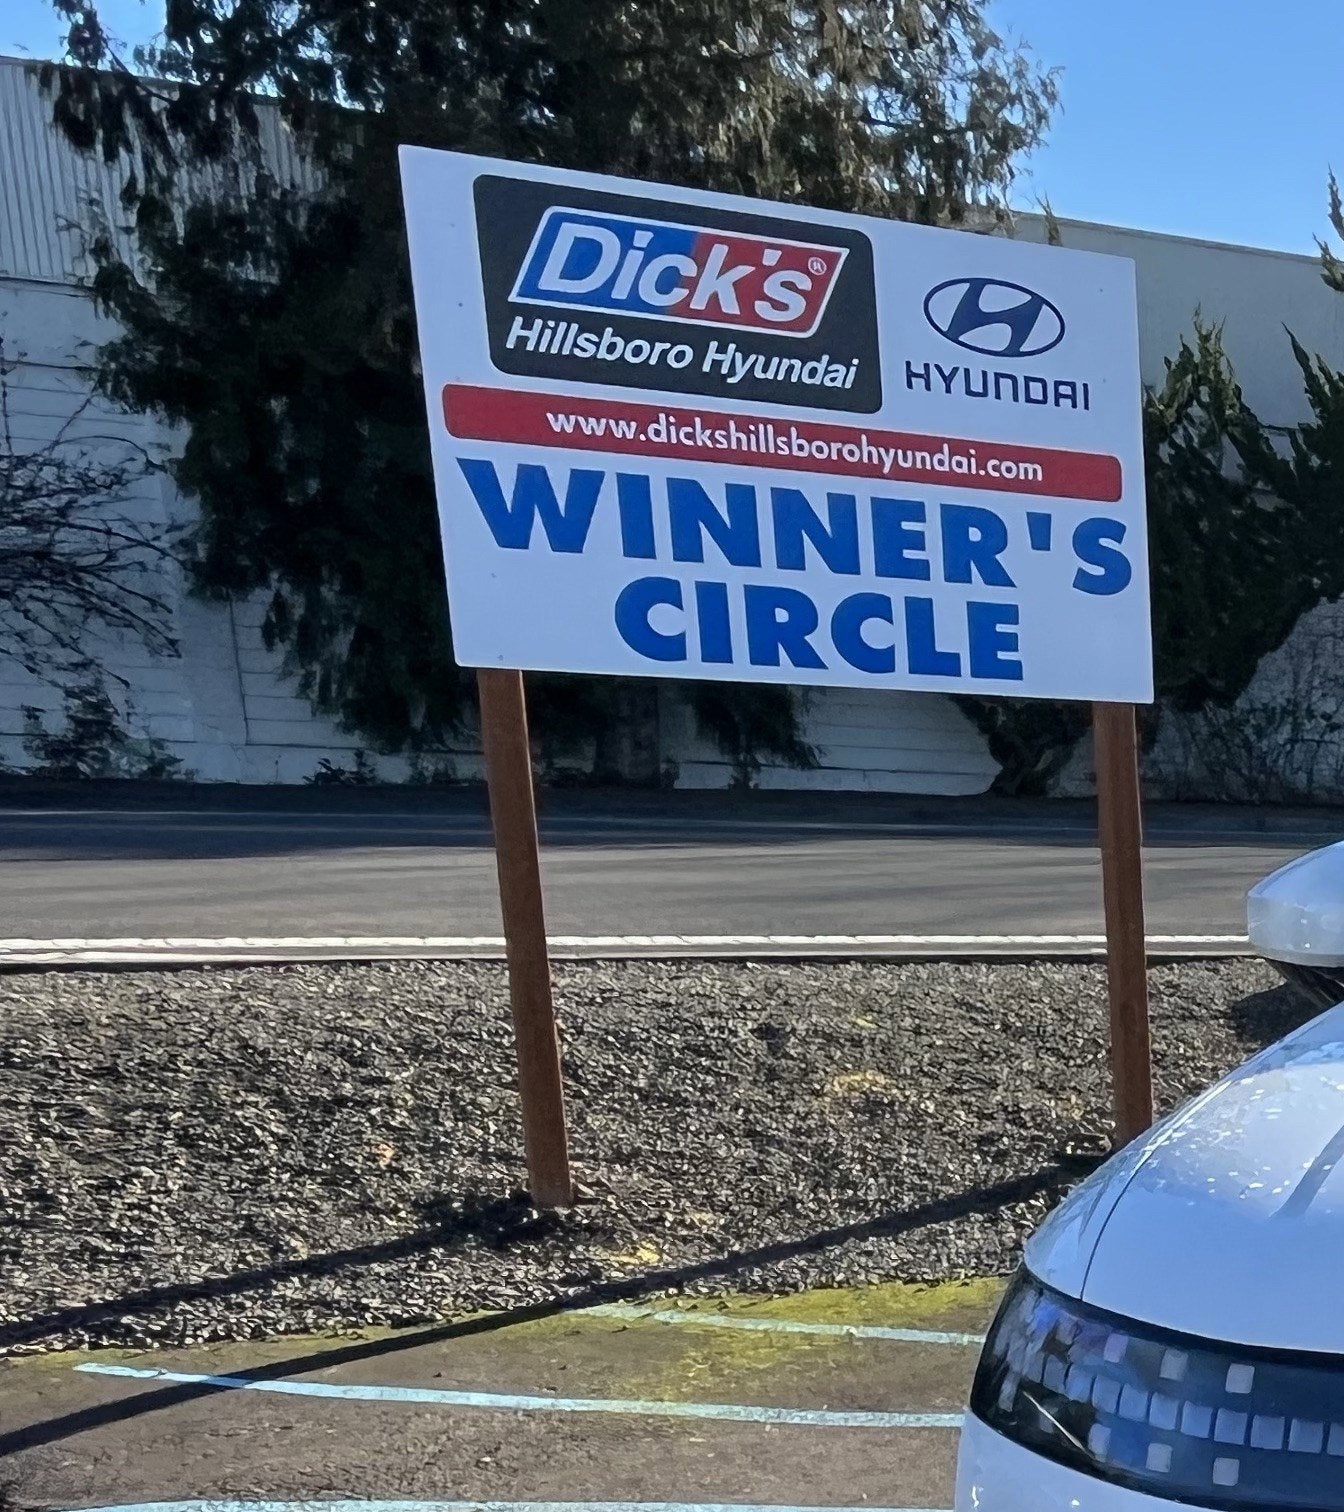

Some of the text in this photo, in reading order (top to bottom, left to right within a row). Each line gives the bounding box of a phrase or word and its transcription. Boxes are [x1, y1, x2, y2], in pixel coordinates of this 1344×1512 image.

[537, 221, 813, 323] Dick's
[505, 315, 860, 390] Hillsboro Hyundai
[905, 360, 1090, 411] HYUNDAI
[545, 410, 1044, 483] www.dickshillsborohyundai.com
[455, 456, 1133, 596] WINNER'S
[613, 575, 1025, 681] CIRCLE
